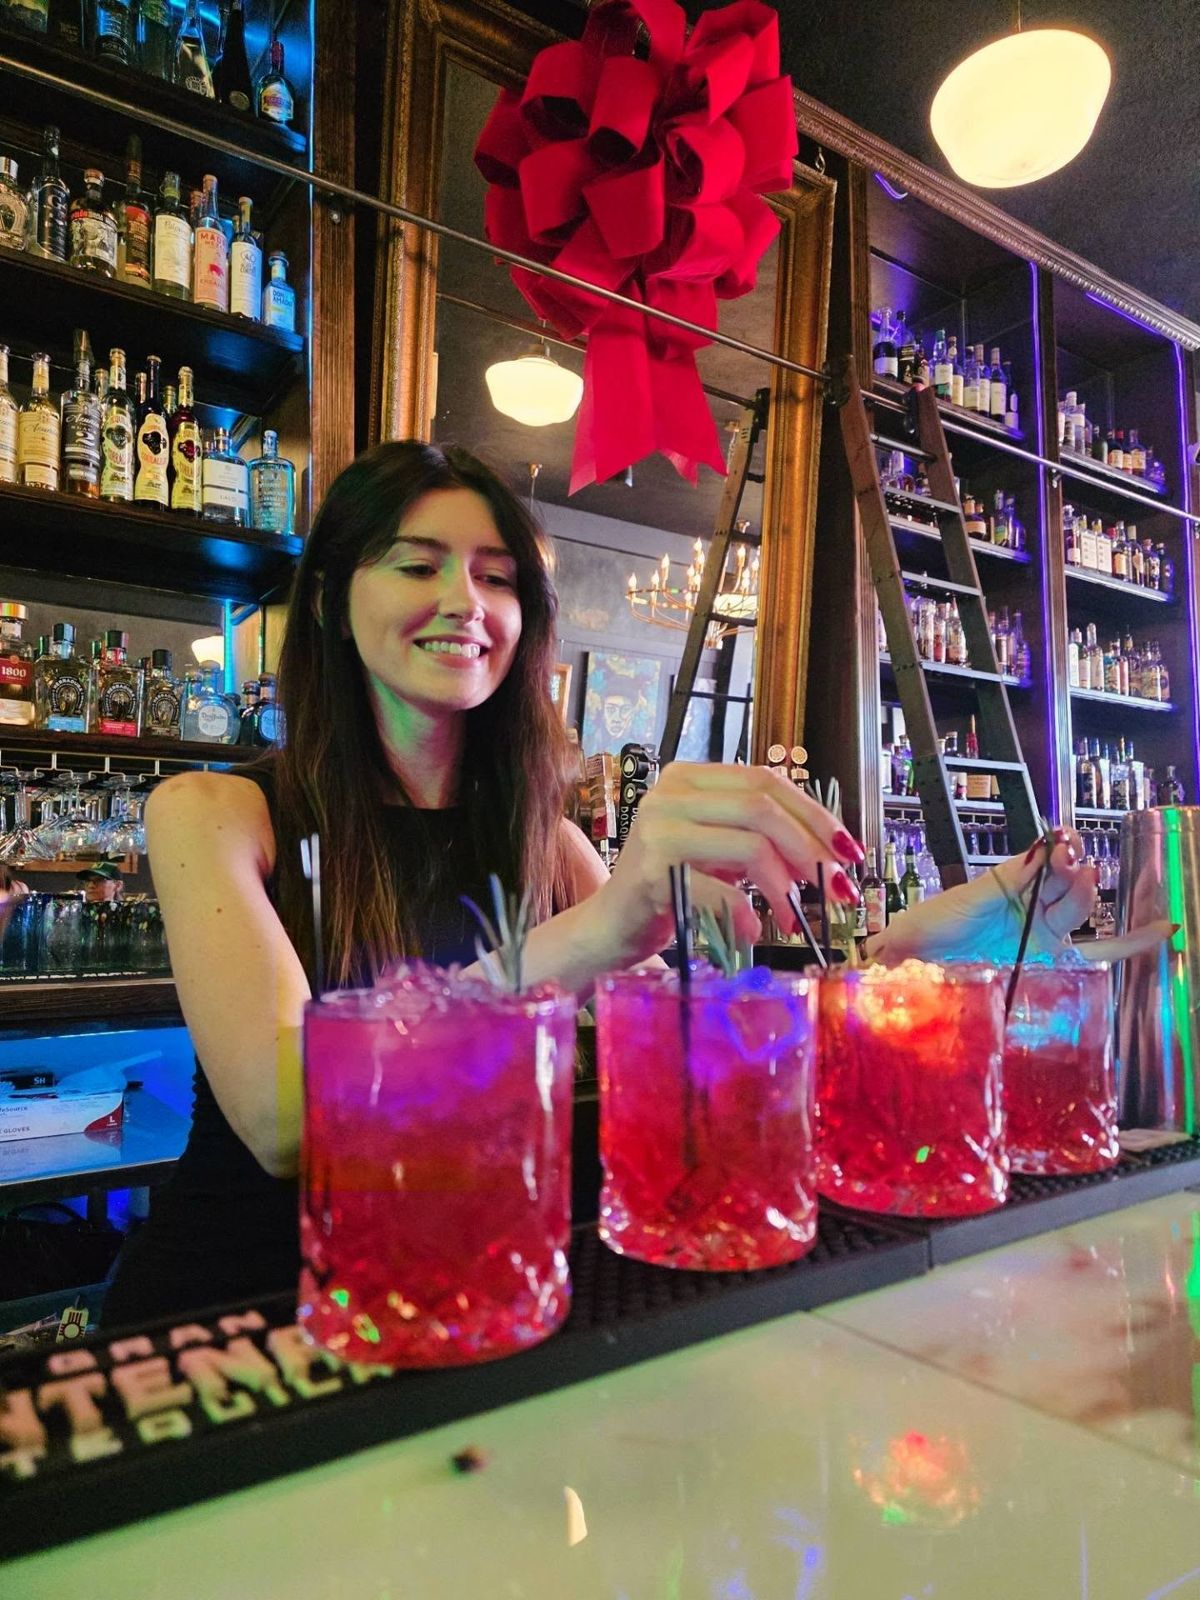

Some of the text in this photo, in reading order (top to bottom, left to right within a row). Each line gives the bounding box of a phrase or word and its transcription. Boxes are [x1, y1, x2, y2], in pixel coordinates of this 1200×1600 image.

[1, 666, 27, 677] 1800
[109, 1115, 116, 1123] L
[3, 1126, 30, 1134] GLOVES
